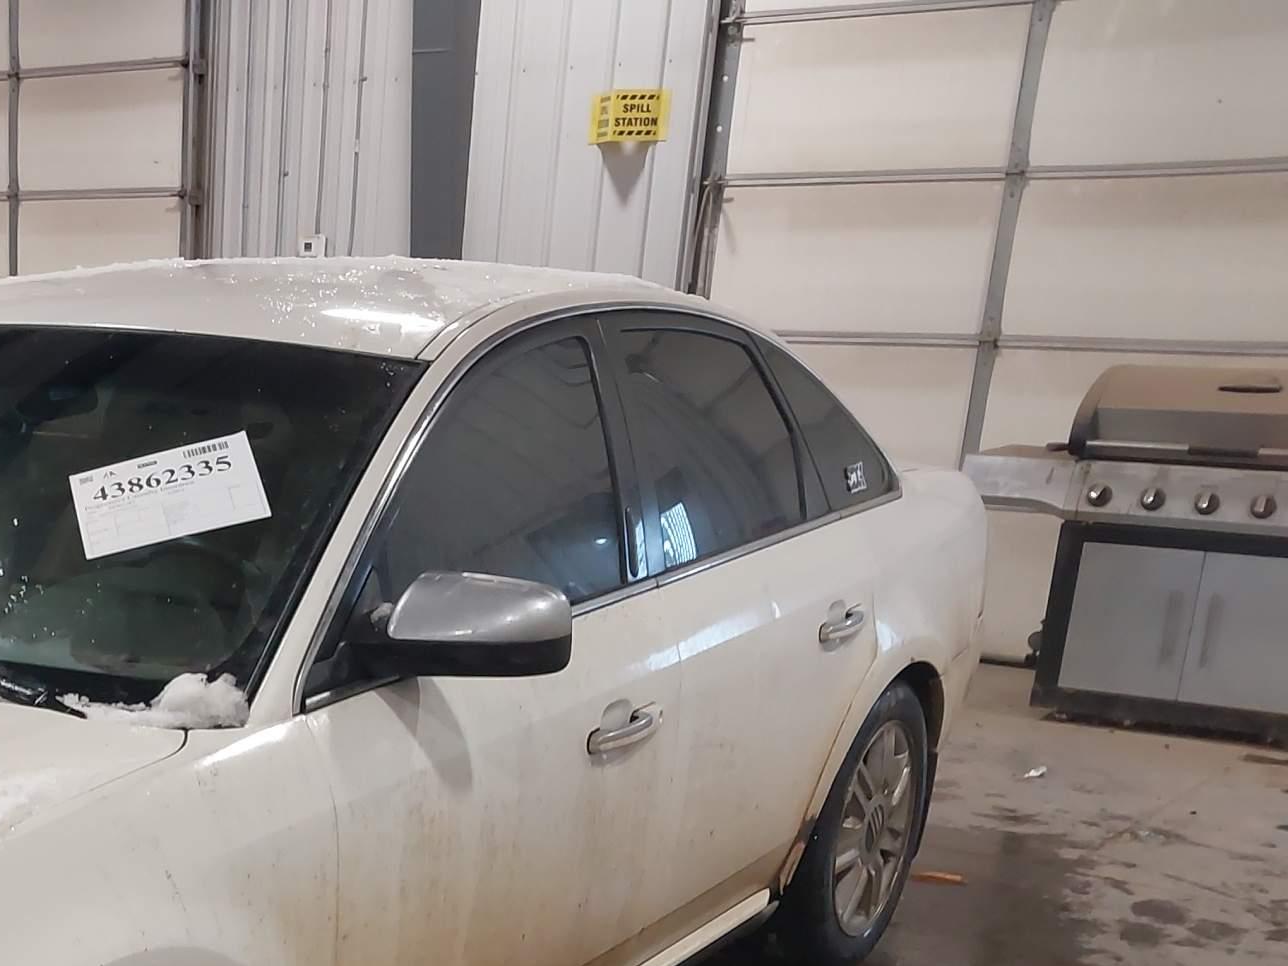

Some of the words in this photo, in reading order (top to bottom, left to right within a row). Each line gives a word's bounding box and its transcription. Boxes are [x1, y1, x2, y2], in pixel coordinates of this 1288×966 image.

[623, 103, 651, 113] SPILL
[614, 117, 658, 127] STATION
[93, 455, 232, 501] 43862335
